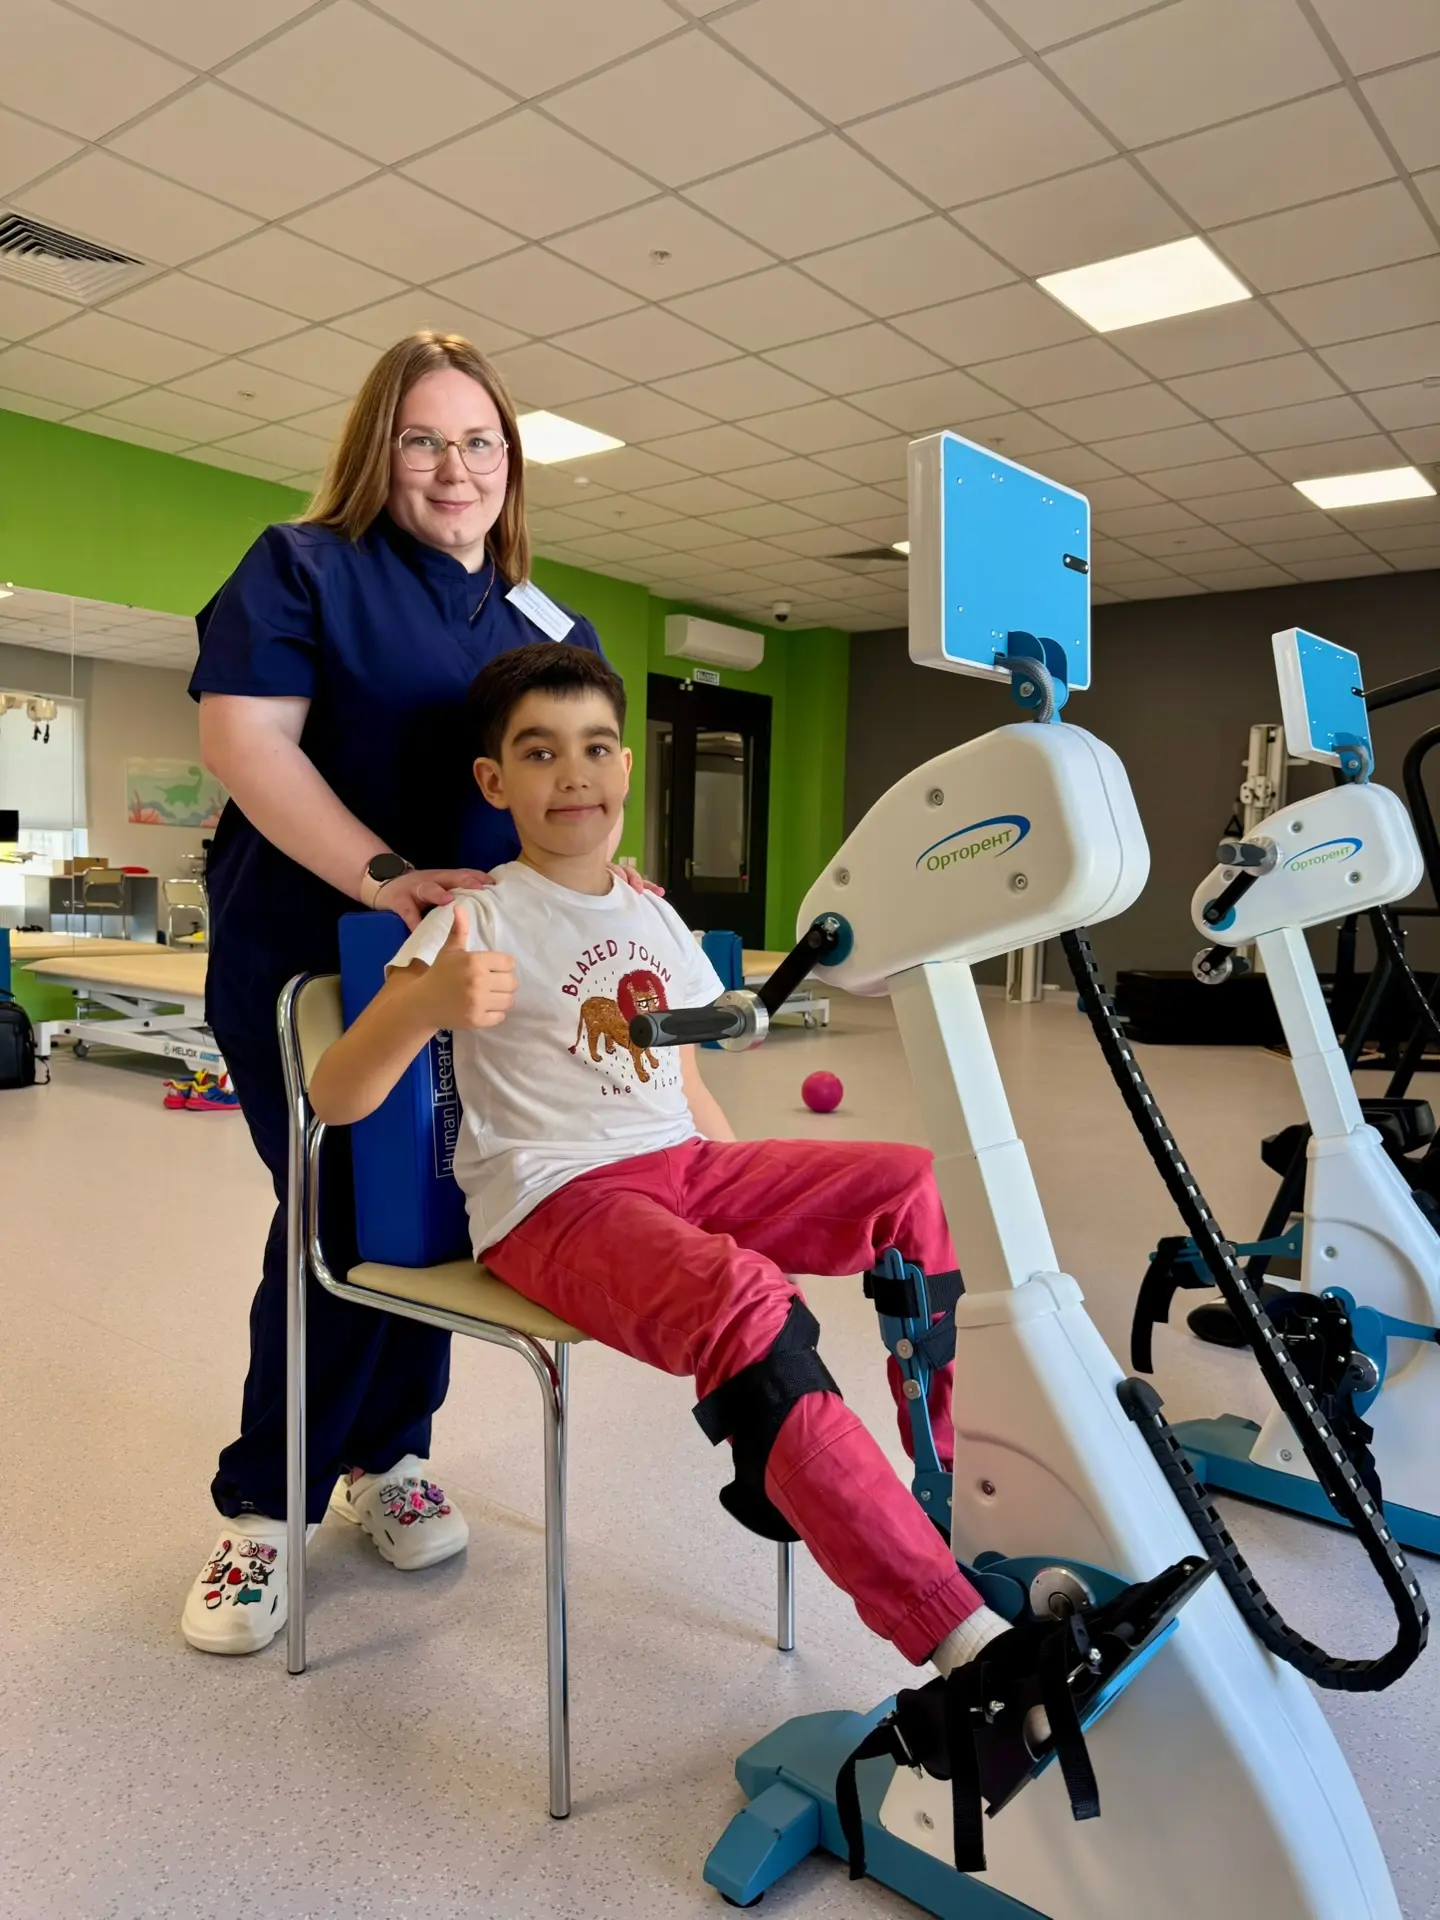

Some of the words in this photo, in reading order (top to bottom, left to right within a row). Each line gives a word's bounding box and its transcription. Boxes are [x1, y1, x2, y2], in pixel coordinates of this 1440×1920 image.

[926, 829, 1013, 871] Орторент
[1290, 846, 1351, 872] Орторент
[561, 939, 618, 997] BLAZED
[627, 941, 672, 983] JOHN
[601, 1084, 632, 1096] the
[442, 1107, 457, 1171] Human
